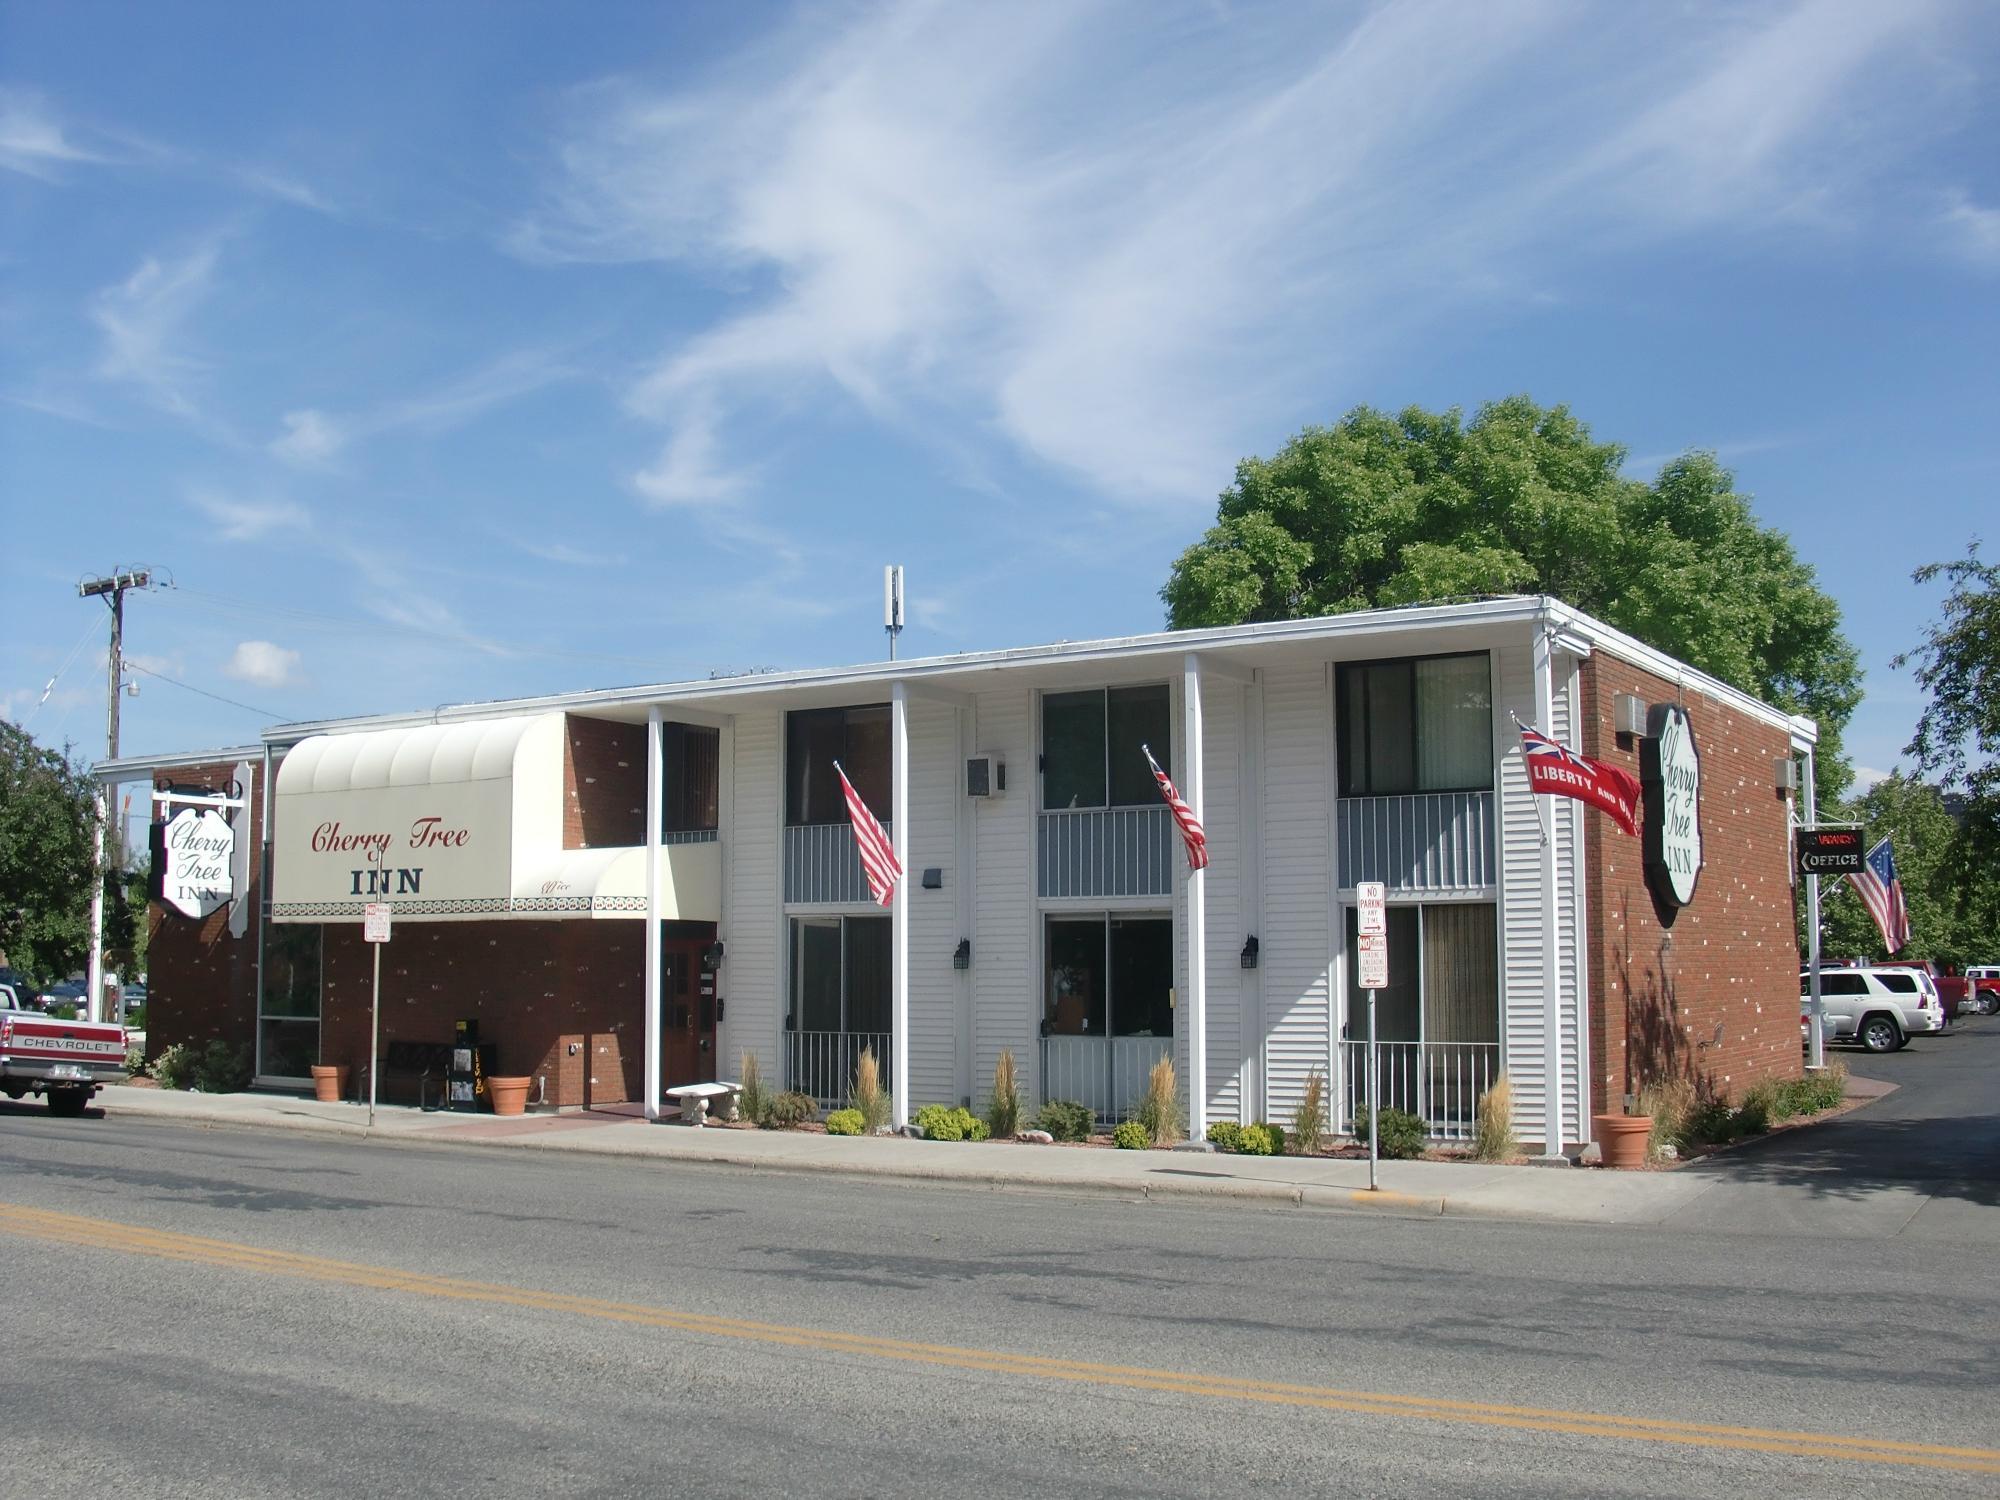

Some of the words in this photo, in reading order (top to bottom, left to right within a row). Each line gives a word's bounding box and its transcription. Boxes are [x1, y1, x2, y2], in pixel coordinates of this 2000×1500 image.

[1662, 726, 1696, 808] Cherry
[1534, 765, 1592, 790] LIBERTY
[1597, 786, 1616, 804] AND
[1667, 793, 1690, 838] Tree
[171, 820, 231, 860] Cherry
[311, 821, 393, 862] Cherry
[409, 817, 471, 848] Tree
[177, 852, 222, 880] Tree
[1667, 846, 1692, 874] INN
[1810, 854, 1858, 866] OFFICE
[178, 885, 218, 900] INN
[350, 867, 423, 896] INN
[1367, 887, 1377, 897] NO
[1360, 899, 1383, 909] PARKING
[1360, 938, 1370, 949] NO
[24, 1038, 112, 1051] CHEVROLET
